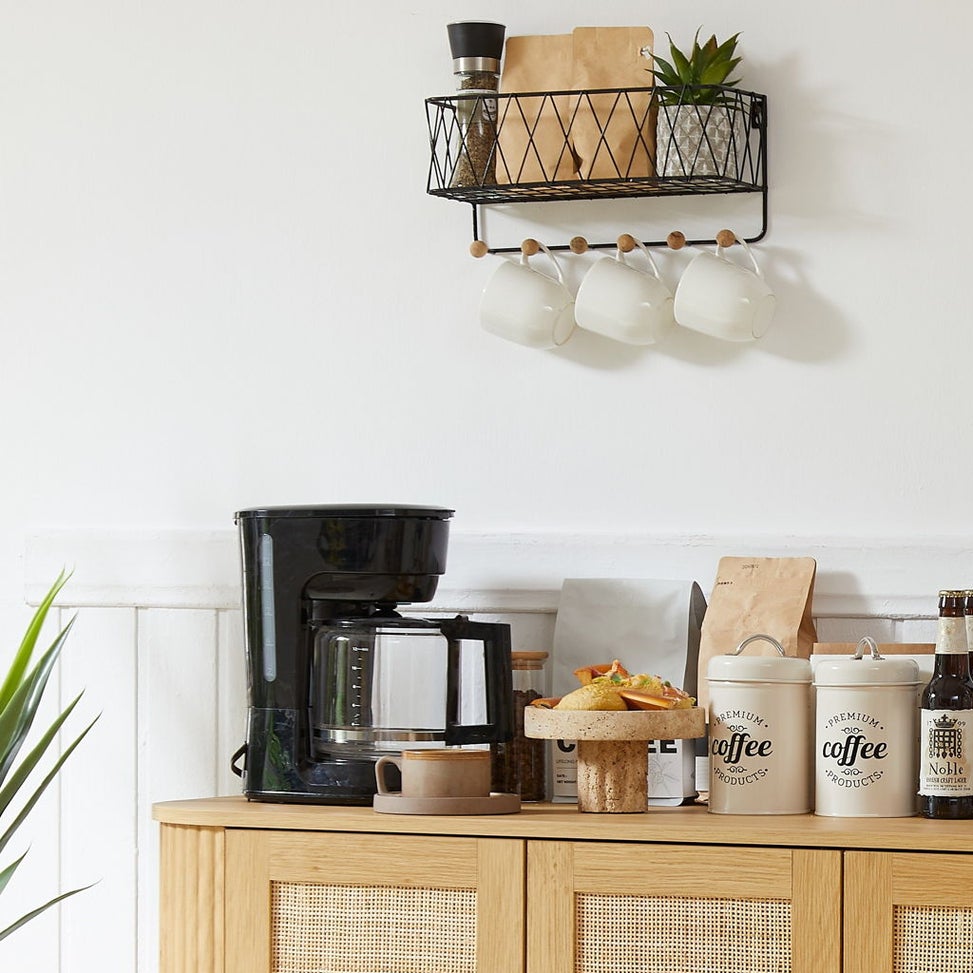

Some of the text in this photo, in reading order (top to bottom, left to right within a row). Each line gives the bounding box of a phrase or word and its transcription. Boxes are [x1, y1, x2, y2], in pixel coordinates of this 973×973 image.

[716, 710, 764, 726] PREMIUM
[828, 712, 880, 728] PREMIUM
[711, 732, 773, 764] coffee
[822, 735, 888, 766] coffee
[714, 768, 766, 786] PRODUCTS
[929, 761, 964, 775] Noble
[826, 770, 882, 788] PRODUCTS
